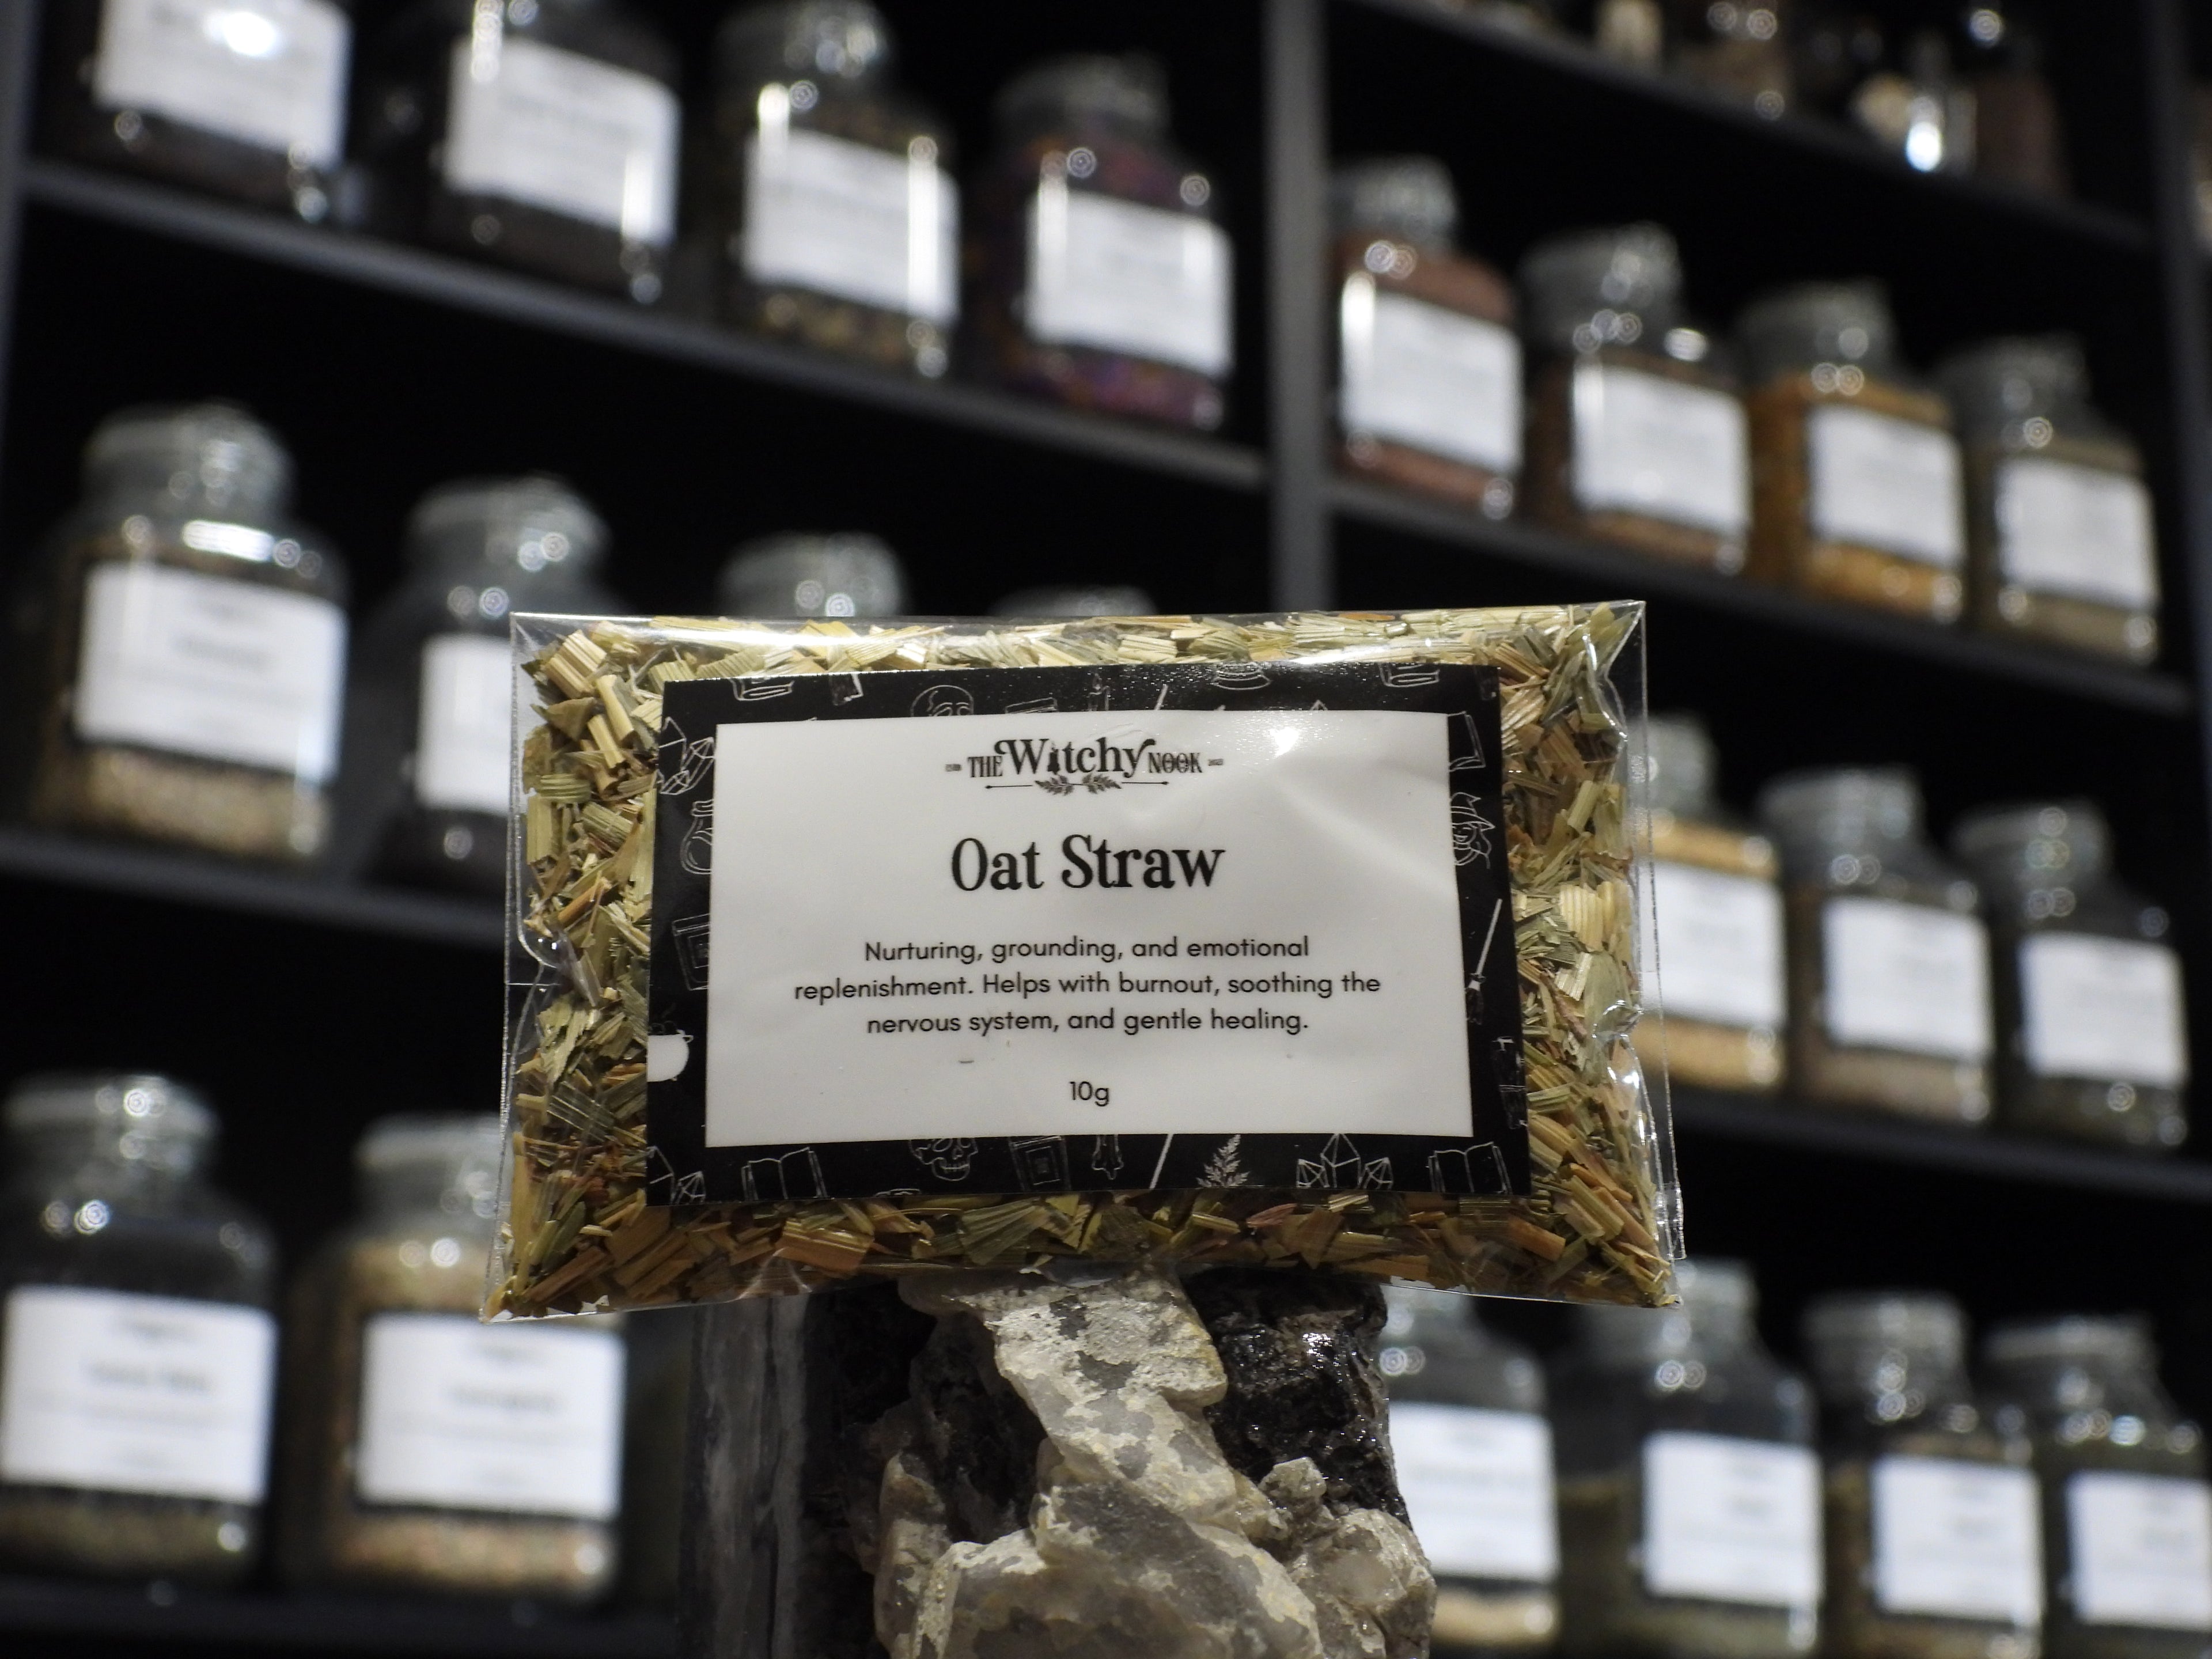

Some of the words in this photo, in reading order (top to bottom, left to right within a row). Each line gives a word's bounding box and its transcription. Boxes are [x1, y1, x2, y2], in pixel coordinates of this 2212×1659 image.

[967, 755, 1003, 778] THE
[994, 737, 1156, 778] Witchy
[1148, 752, 1203, 774] NOOK
[951, 837, 1044, 891] Oat
[1061, 834, 1226, 889] Straw
[865, 941, 983, 964] Nurturing,
[991, 935, 1123, 964] grounding,
[1132, 935, 1177, 957] and
[1187, 935, 1309, 957] emotional
[794, 975, 974, 1005] replenishment.
[983, 971, 1051, 999] Helps
[1059, 971, 1110, 993] with
[1119, 971, 1220, 996] burnout,
[1228, 971, 1332, 998] soothing
[1342, 971, 1381, 992] the
[868, 1016, 961, 1033] nervous
[969, 1012, 1059, 1036] system,
[1068, 1007, 1114, 1030] and
[1123, 1007, 1202, 1035] gentle
[1210, 1007, 1309, 1035] healing.
[1069, 1081, 1110, 1107] 10g
